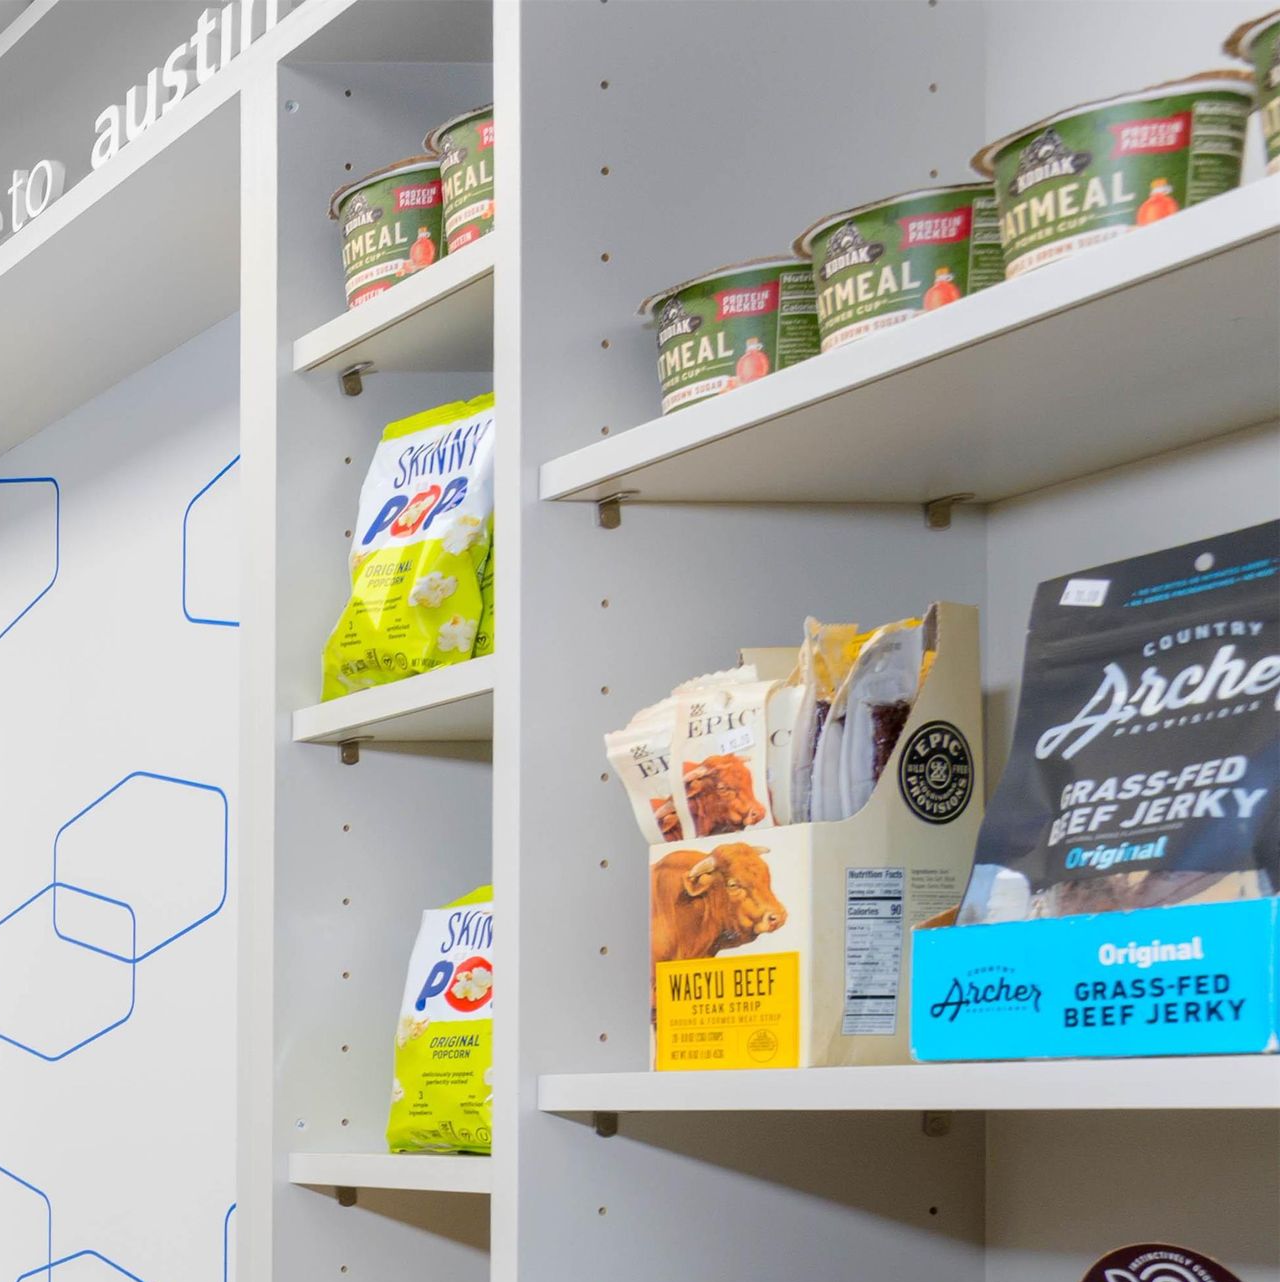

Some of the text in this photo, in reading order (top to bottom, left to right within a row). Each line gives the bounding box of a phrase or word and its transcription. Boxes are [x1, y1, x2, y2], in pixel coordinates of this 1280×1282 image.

[7, 159, 66, 232] to
[824, 246, 872, 280] KODIAK
[722, 289, 770, 306] PROTEIN
[393, 420, 492, 490] SKINNY
[361, 476, 469, 546] POP
[364, 560, 413, 579] ORIGINAL
[367, 576, 406, 589] POPCORN
[1142, 621, 1265, 657] COUNTRY
[1034, 644, 1280, 760] Arche
[915, 732, 962, 757] EPIC
[1059, 755, 1248, 811] GRASS-FED
[1047, 803, 1118, 848] BEEF
[1119, 787, 1268, 830] JERKY
[1064, 835, 1170, 870] Original
[1098, 936, 1204, 969] Original
[669, 967, 777, 1002] WAGYU BEEF
[929, 976, 1042, 1023] Archer
[1074, 973, 1231, 1002] GRASS-FED
[692, 1001, 761, 1015] STEAK STRIP
[1064, 998, 1247, 1028] BEEF JERKY
[429, 1034, 480, 1048] ORIGINAL
[432, 1049, 471, 1060] POPCORN
[1128, 1251, 1193, 1272] INSTINCTIVELY
